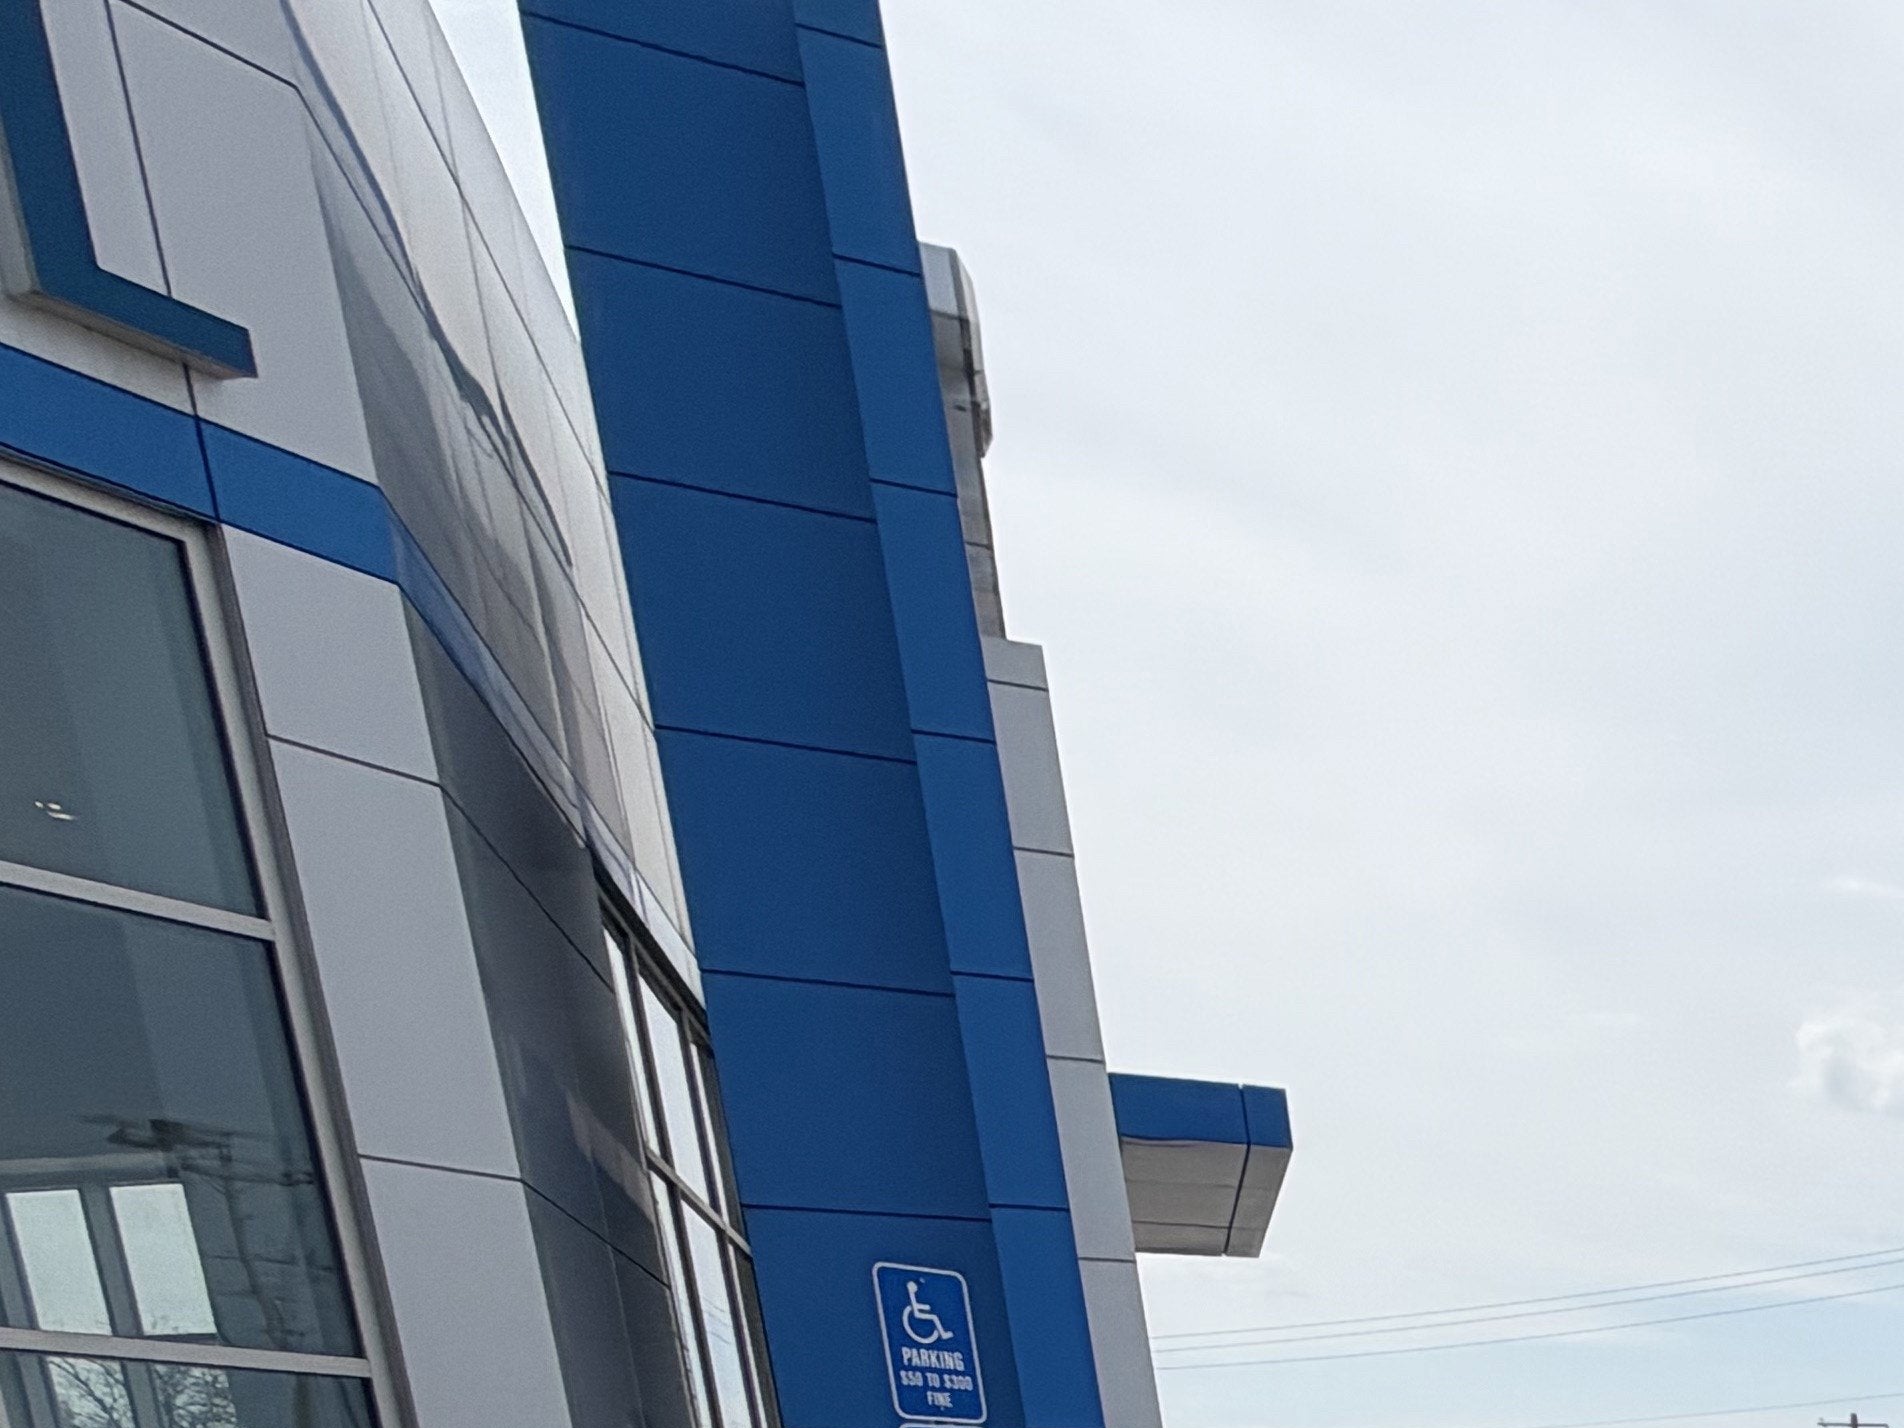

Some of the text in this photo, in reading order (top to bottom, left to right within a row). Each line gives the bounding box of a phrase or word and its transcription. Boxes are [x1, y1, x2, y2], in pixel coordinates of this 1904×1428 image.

[902, 1346, 964, 1371] PARKING
[900, 1371, 974, 1391] $50 TO $300
[926, 1391, 953, 1408] FINE
